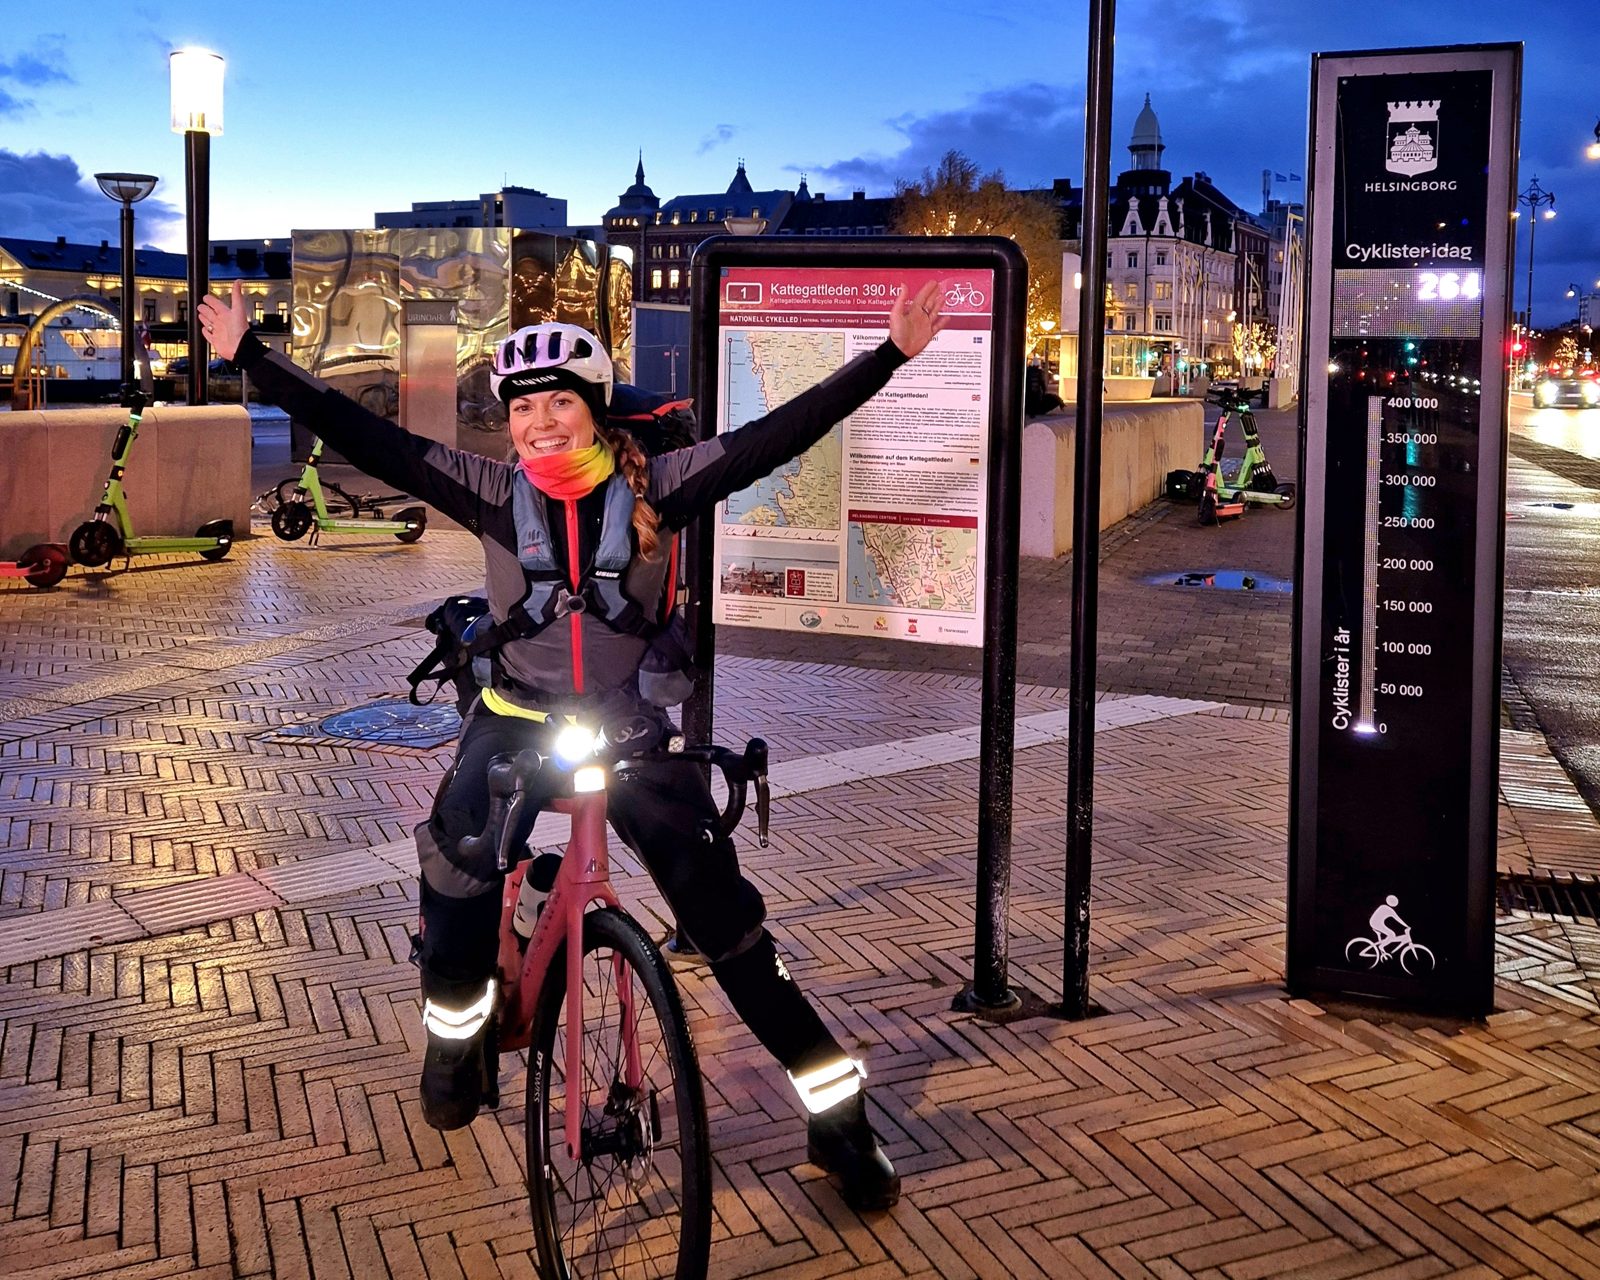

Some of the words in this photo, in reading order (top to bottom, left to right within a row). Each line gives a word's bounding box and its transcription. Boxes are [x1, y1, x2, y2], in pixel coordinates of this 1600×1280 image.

[1365, 181, 1457, 192] HELSINGBORG
[1346, 243, 1429, 262] Cyklister
[1432, 243, 1472, 261] idag
[770, 283, 858, 298] Kattegattleden
[862, 284, 886, 296] 390
[1418, 272, 1480, 300] 264
[740, 286, 747, 299] 1
[812, 298, 833, 306] Bicycle
[729, 315, 764, 323] NATIONELL
[765, 315, 799, 323] CYKELLED
[512, 374, 558, 386] CANYON
[885, 391, 928, 399] Kattegattleden!
[1388, 397, 1411, 409] 400
[1414, 398, 1438, 409] 000
[1386, 433, 1410, 444] 350
[1413, 434, 1437, 445] 000
[1385, 475, 1409, 486] 300
[1412, 476, 1436, 487] 000
[1384, 517, 1408, 527] 250
[1411, 518, 1435, 529] 000
[1383, 558, 1407, 570] 200
[1410, 559, 1434, 571] 000
[1382, 600, 1406, 612] 150
[1409, 601, 1433, 613] 000
[1334, 626, 1350, 645] år
[1382, 641, 1405, 653] 100
[1408, 643, 1432, 655] 000
[1332, 655, 1352, 730] Cyklister
[1380, 683, 1396, 695] 50
[1399, 684, 1423, 696] 000
[1379, 723, 1388, 733] 0
